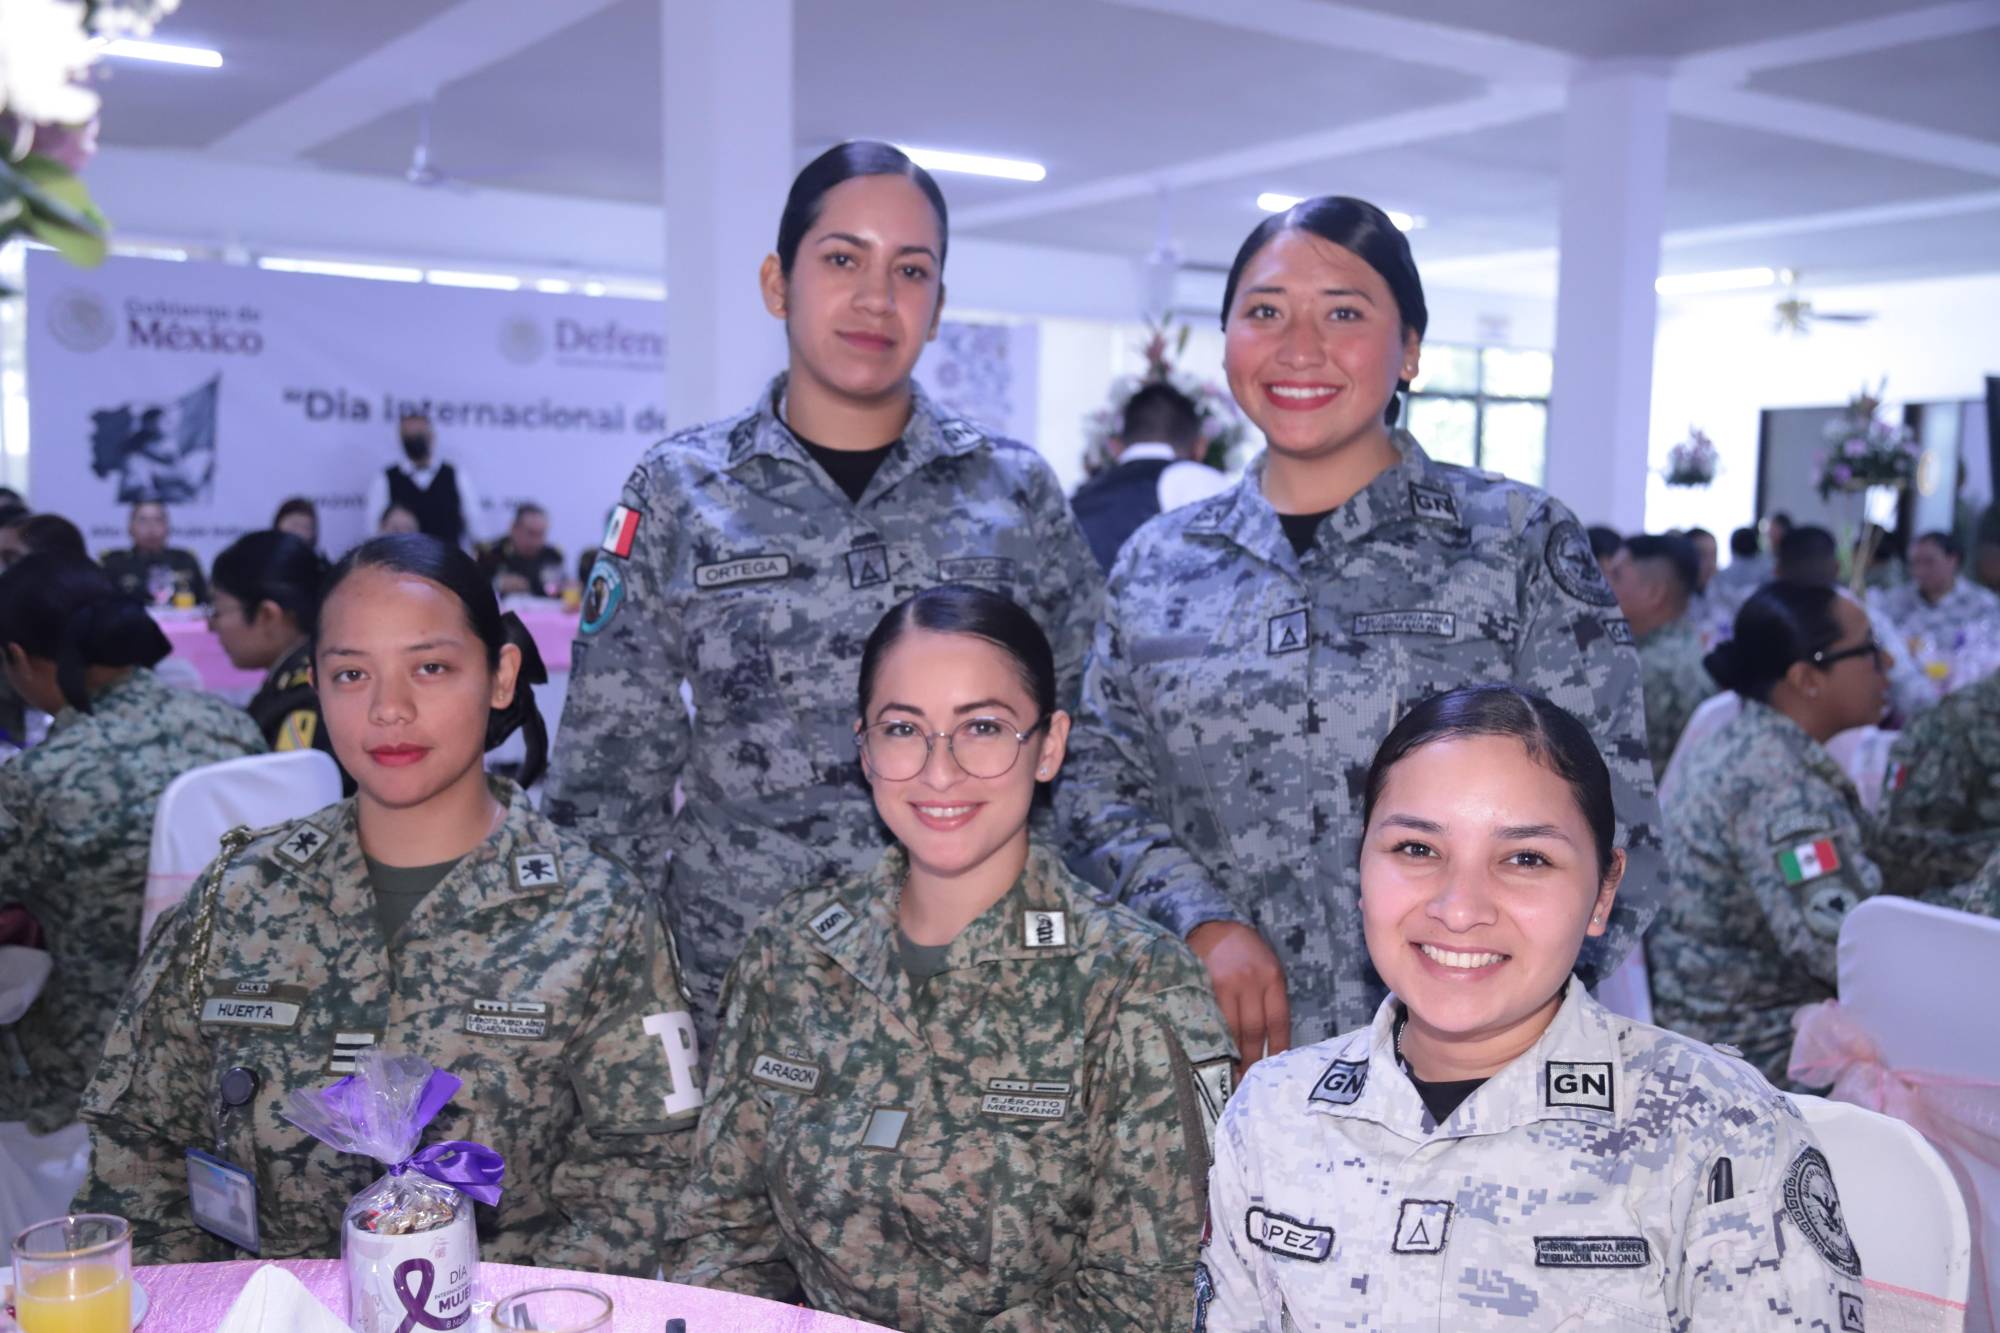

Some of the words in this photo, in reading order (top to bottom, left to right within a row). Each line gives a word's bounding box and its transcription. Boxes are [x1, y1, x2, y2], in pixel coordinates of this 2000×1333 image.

[128, 318, 264, 356] México
[1415, 493, 1451, 513] GN
[705, 560, 778, 581] ORTEGA
[217, 1003, 273, 1019] HUERTA
[642, 1010, 704, 1115] P
[759, 1060, 816, 1084] ARAGON
[1324, 1072, 1366, 1094] GN
[1554, 1073, 1606, 1096] GN
[987, 1103, 1060, 1116] MEXICANO
[1582, 1242, 1613, 1252] FUERZA
[1550, 1253, 1592, 1263] GUARDIA
[1594, 1253, 1644, 1263] NACIONAL
[450, 1263, 468, 1284] DÍA
